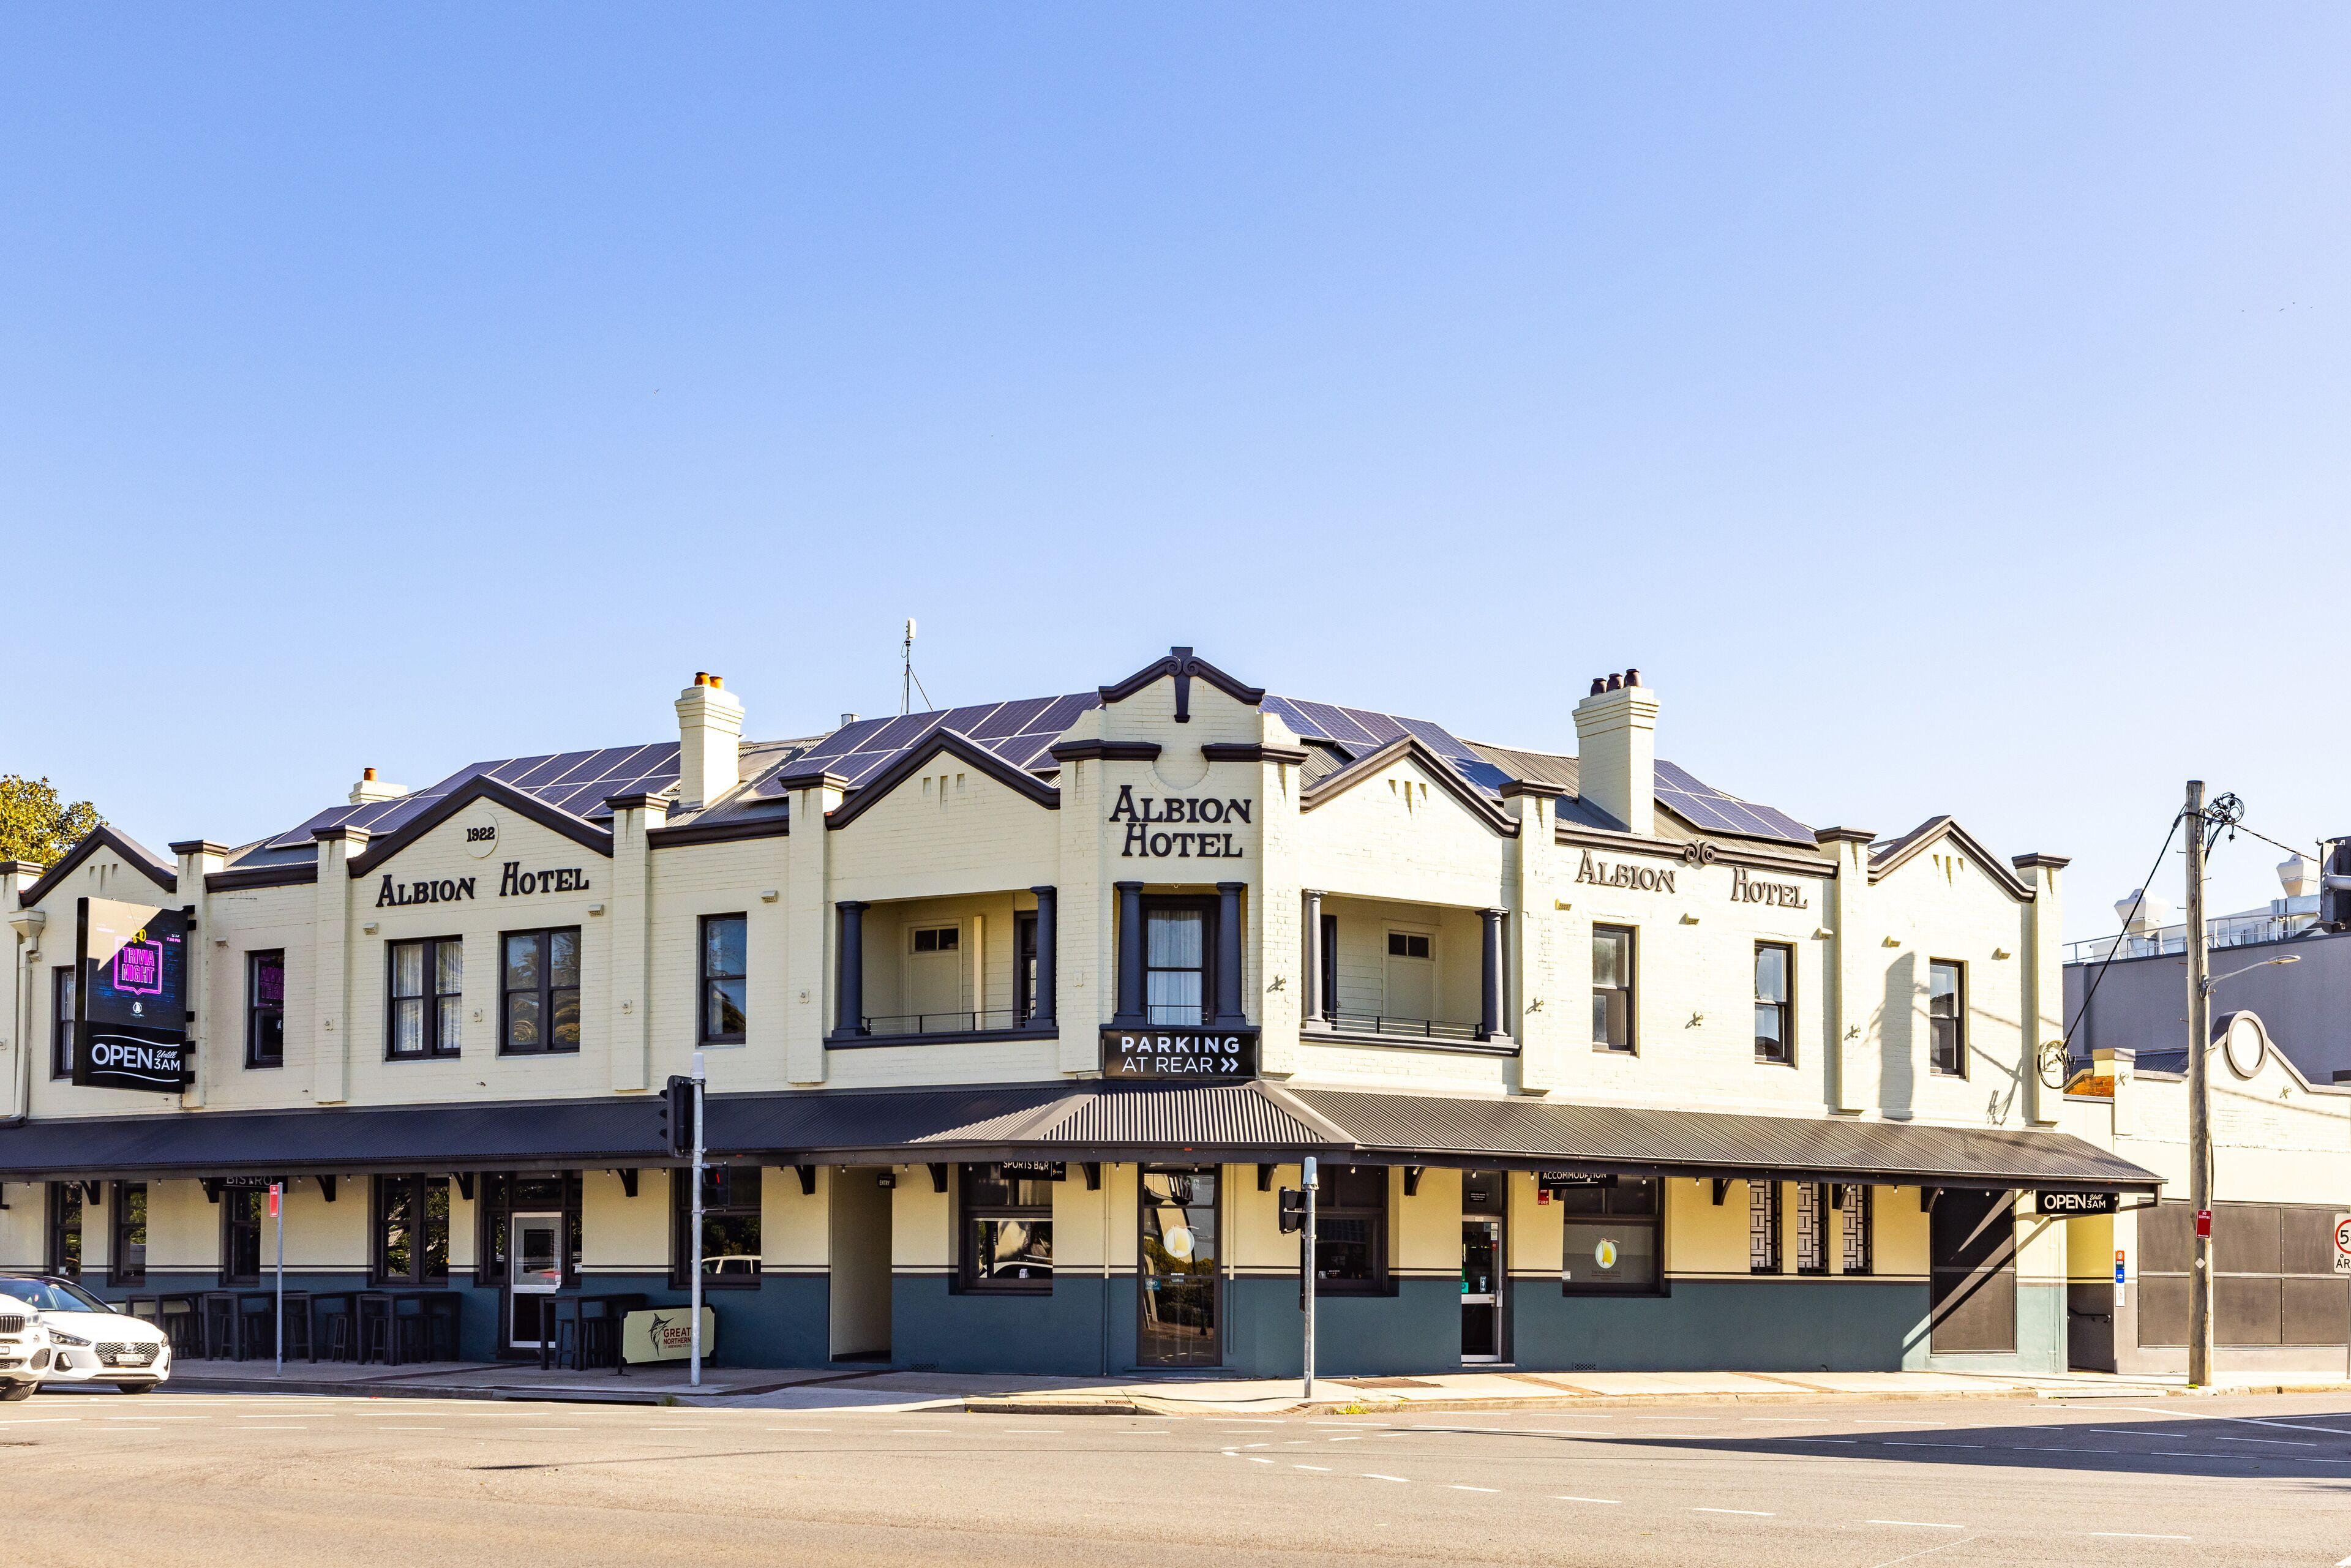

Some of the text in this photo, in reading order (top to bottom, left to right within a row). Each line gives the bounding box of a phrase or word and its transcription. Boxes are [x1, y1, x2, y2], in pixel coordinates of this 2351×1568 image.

[1109, 785, 1251, 823] ALBION
[467, 827, 495, 842] 1922
[1122, 823, 1243, 857] HOTEL
[376, 861, 589, 907] ALBION HOTEL
[1575, 848, 1808, 909] ALBION HOTEL
[122, 947, 154, 966] TRIVIA
[122, 964, 154, 983] NIGHT
[1122, 1037, 1239, 1053] PARKING
[92, 1043, 152, 1069] OPEN
[154, 1058, 181, 1071] 3AM
[1122, 1057, 1213, 1072] AT REAR
[2044, 1195, 2086, 1209] OPEN
[2340, 1230, 2351, 1244] 5
[664, 1327, 691, 1338] GREAT
